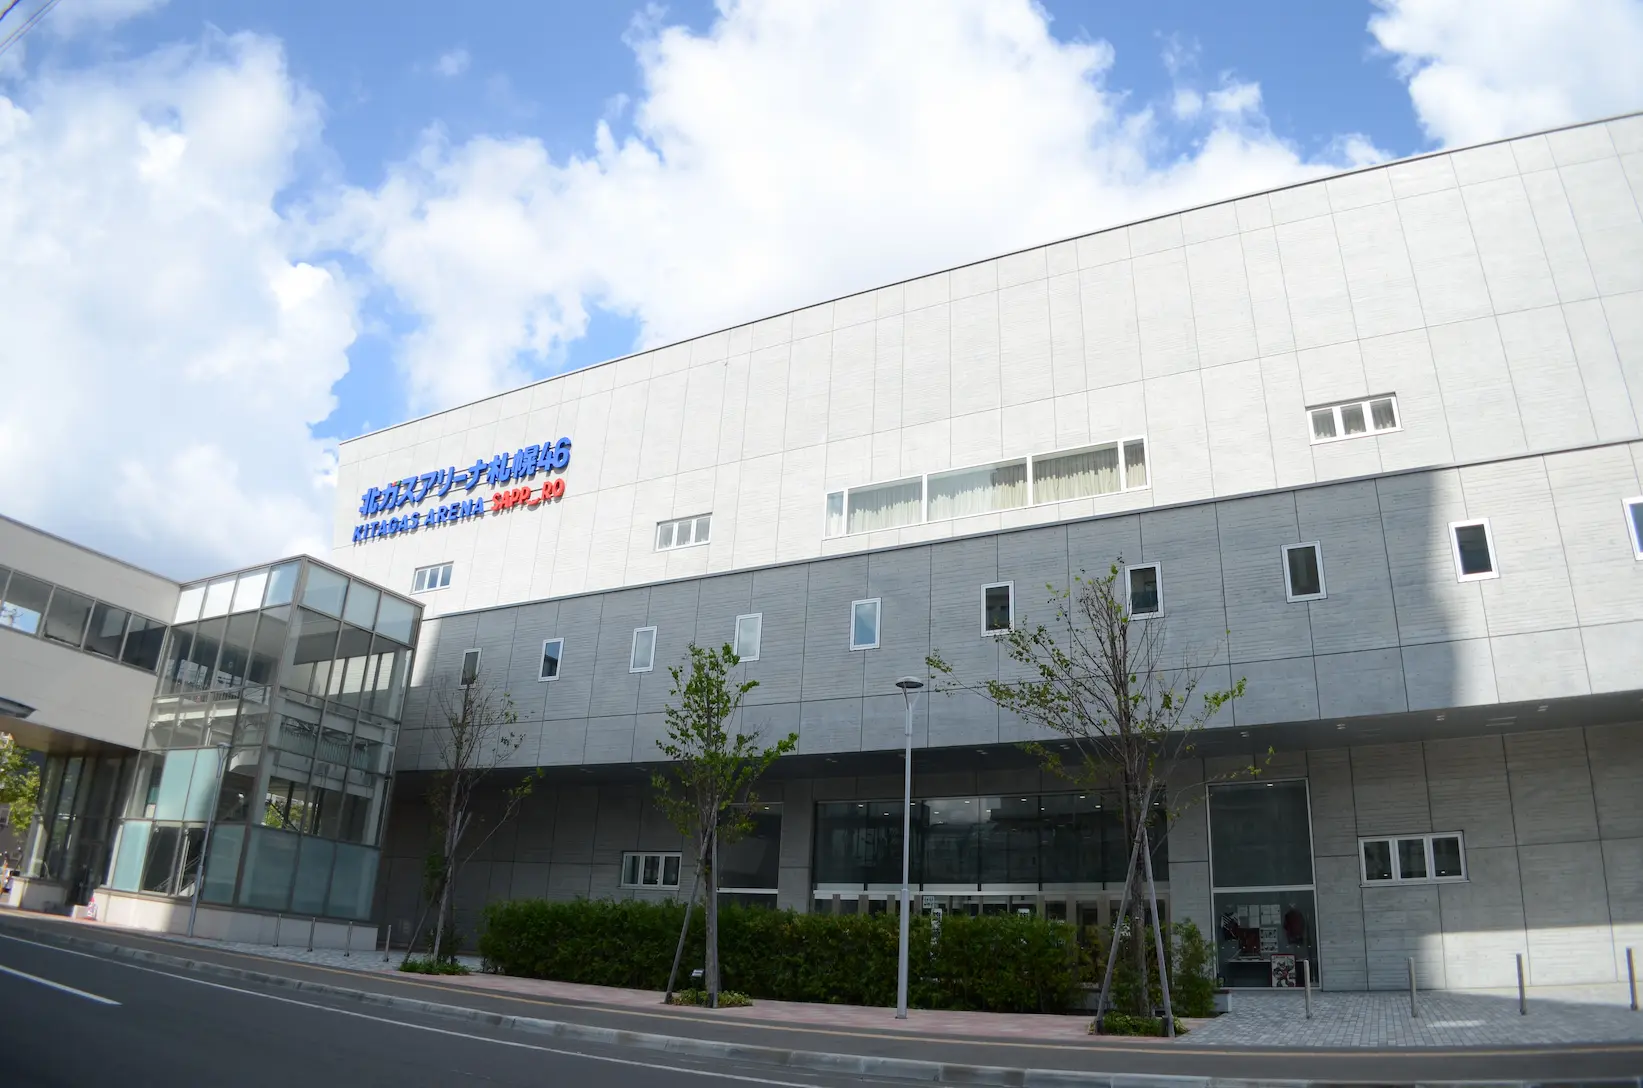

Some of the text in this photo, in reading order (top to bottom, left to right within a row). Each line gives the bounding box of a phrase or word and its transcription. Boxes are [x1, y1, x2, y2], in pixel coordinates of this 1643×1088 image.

[359, 437, 571, 516] 北ガスアリーナ札幌46
[352, 512, 420, 543] KITAGAS
[424, 497, 484, 527] ARENA
